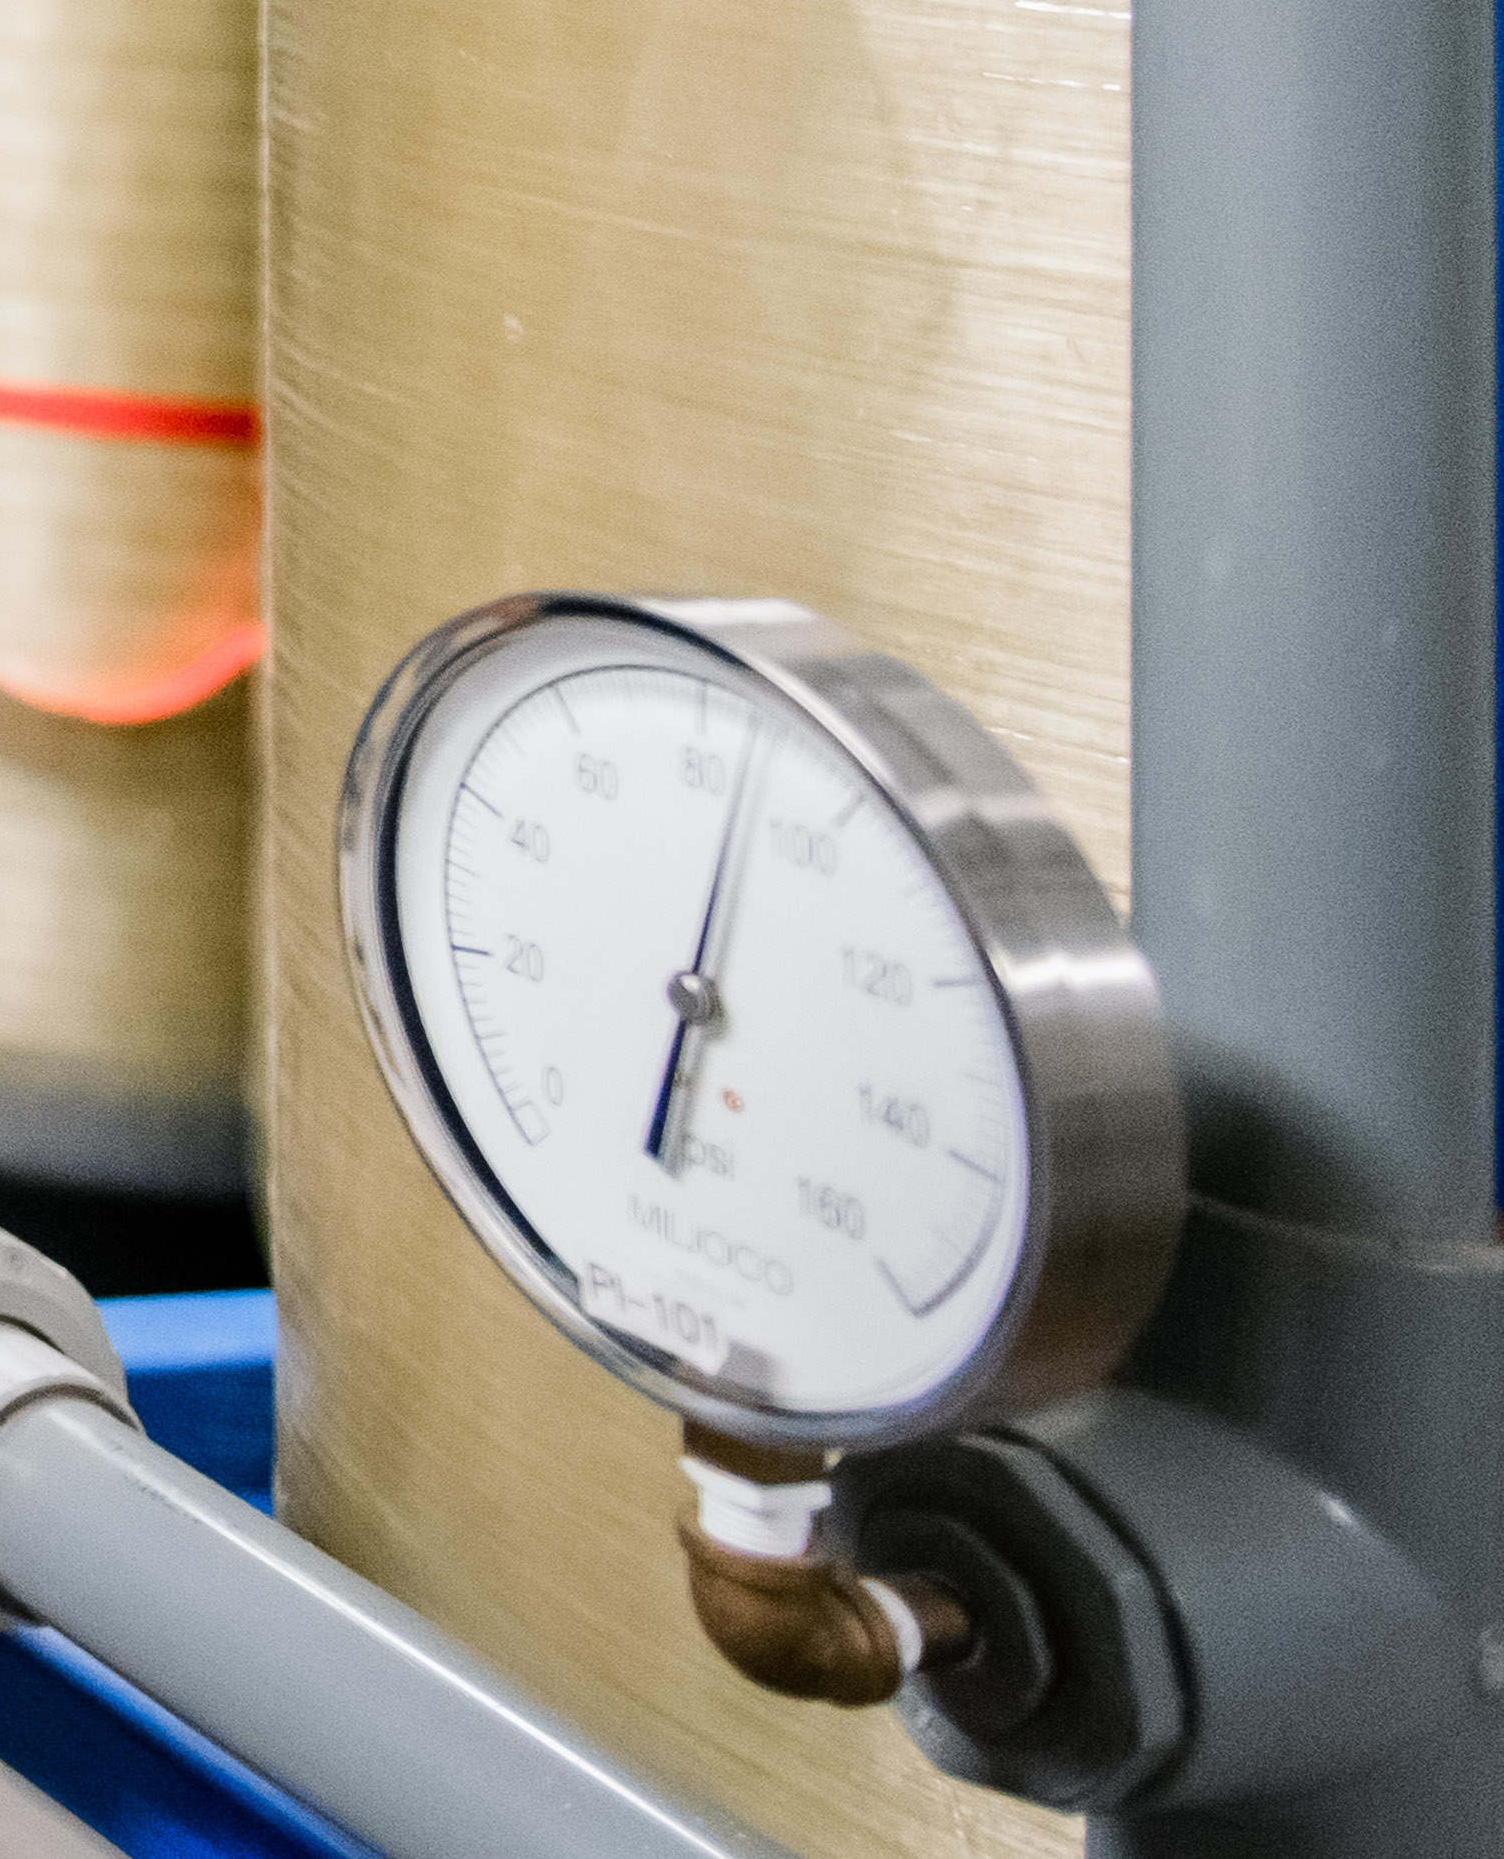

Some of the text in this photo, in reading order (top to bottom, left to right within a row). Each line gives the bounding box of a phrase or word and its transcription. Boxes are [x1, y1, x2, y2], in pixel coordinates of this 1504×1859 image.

[576, 753, 620, 800] 60
[685, 746, 728, 796] 80
[509, 817, 551, 865] 40
[770, 817, 837, 877] 100
[505, 934, 545, 984] 20
[841, 946, 914, 1008] 120
[541, 1066, 565, 1108] 0
[857, 1082, 932, 1148] 140
[796, 1176, 867, 1241] 160
[629, 1192, 794, 1297] MILJOCO
[587, 1261, 720, 1354] PI-101
